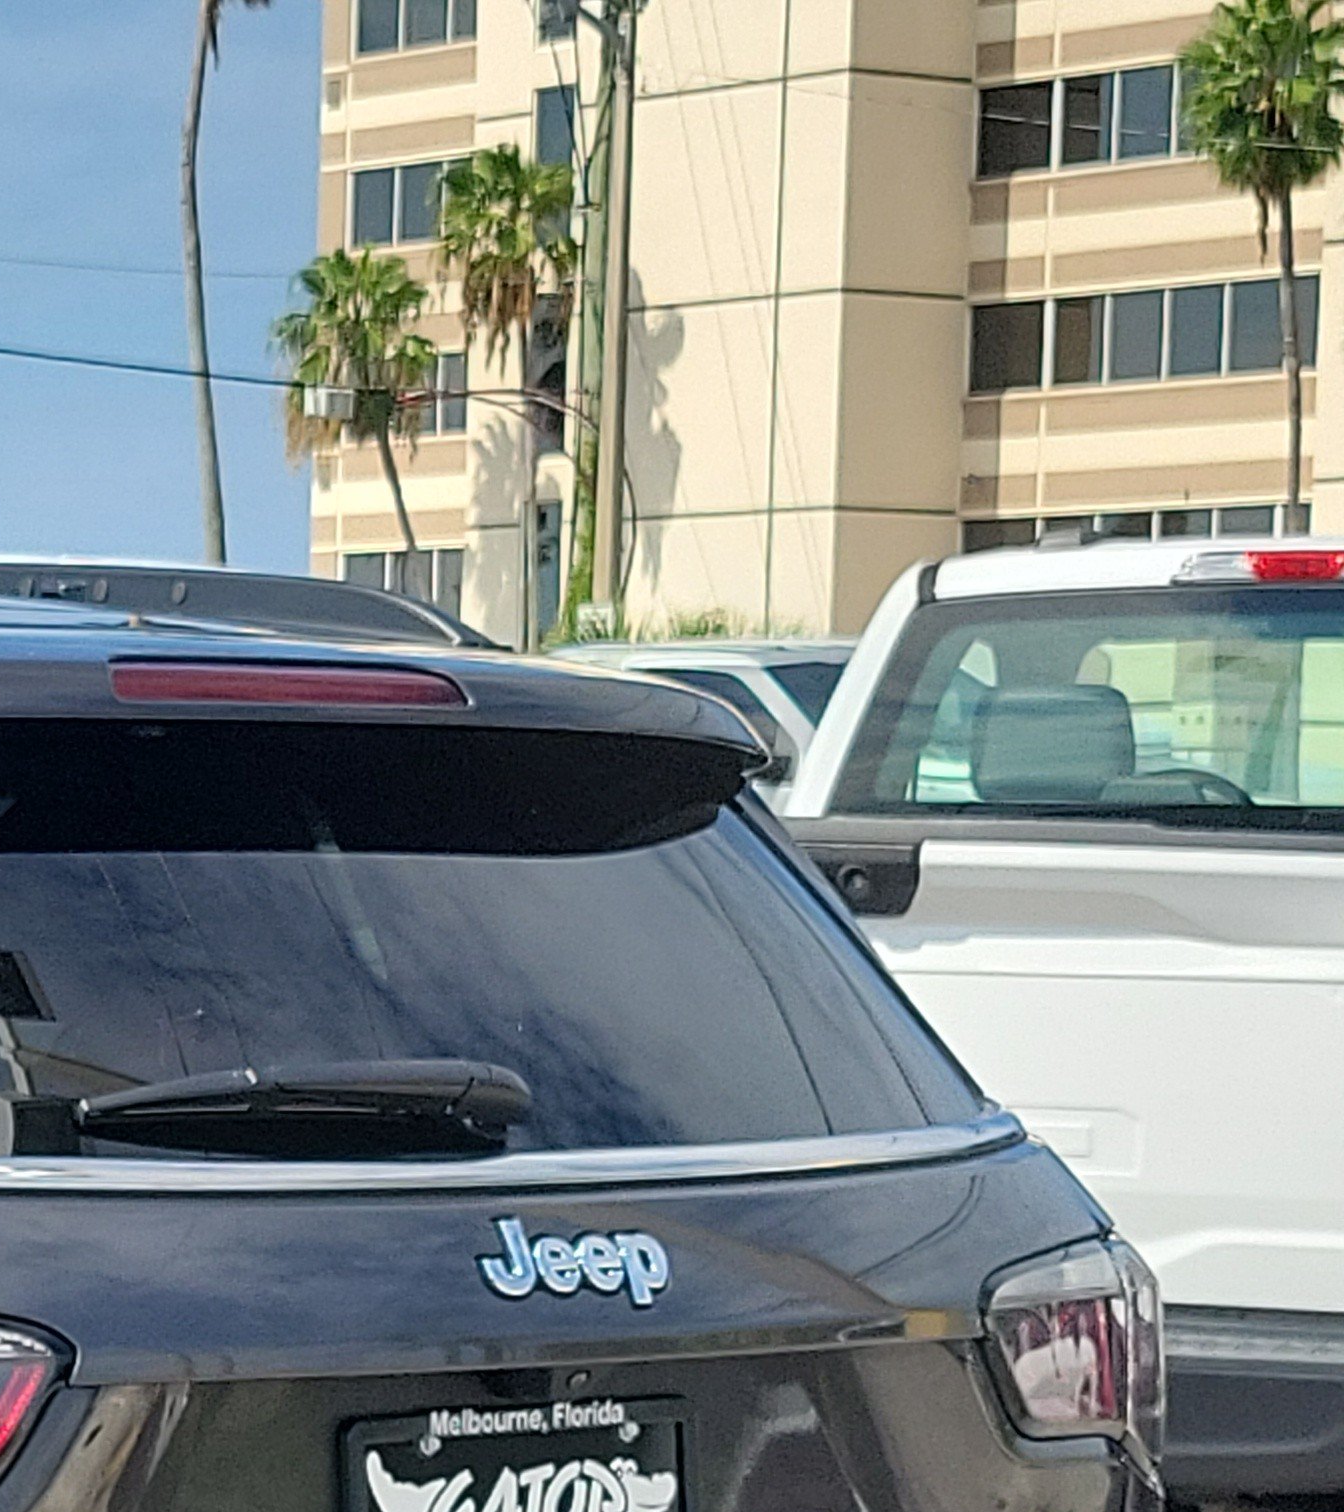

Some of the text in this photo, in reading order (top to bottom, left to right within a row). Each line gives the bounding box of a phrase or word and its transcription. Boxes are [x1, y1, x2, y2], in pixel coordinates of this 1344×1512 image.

[477, 1216, 669, 1305] Jeep
[429, 1401, 624, 1437] Melbourne, Florida
